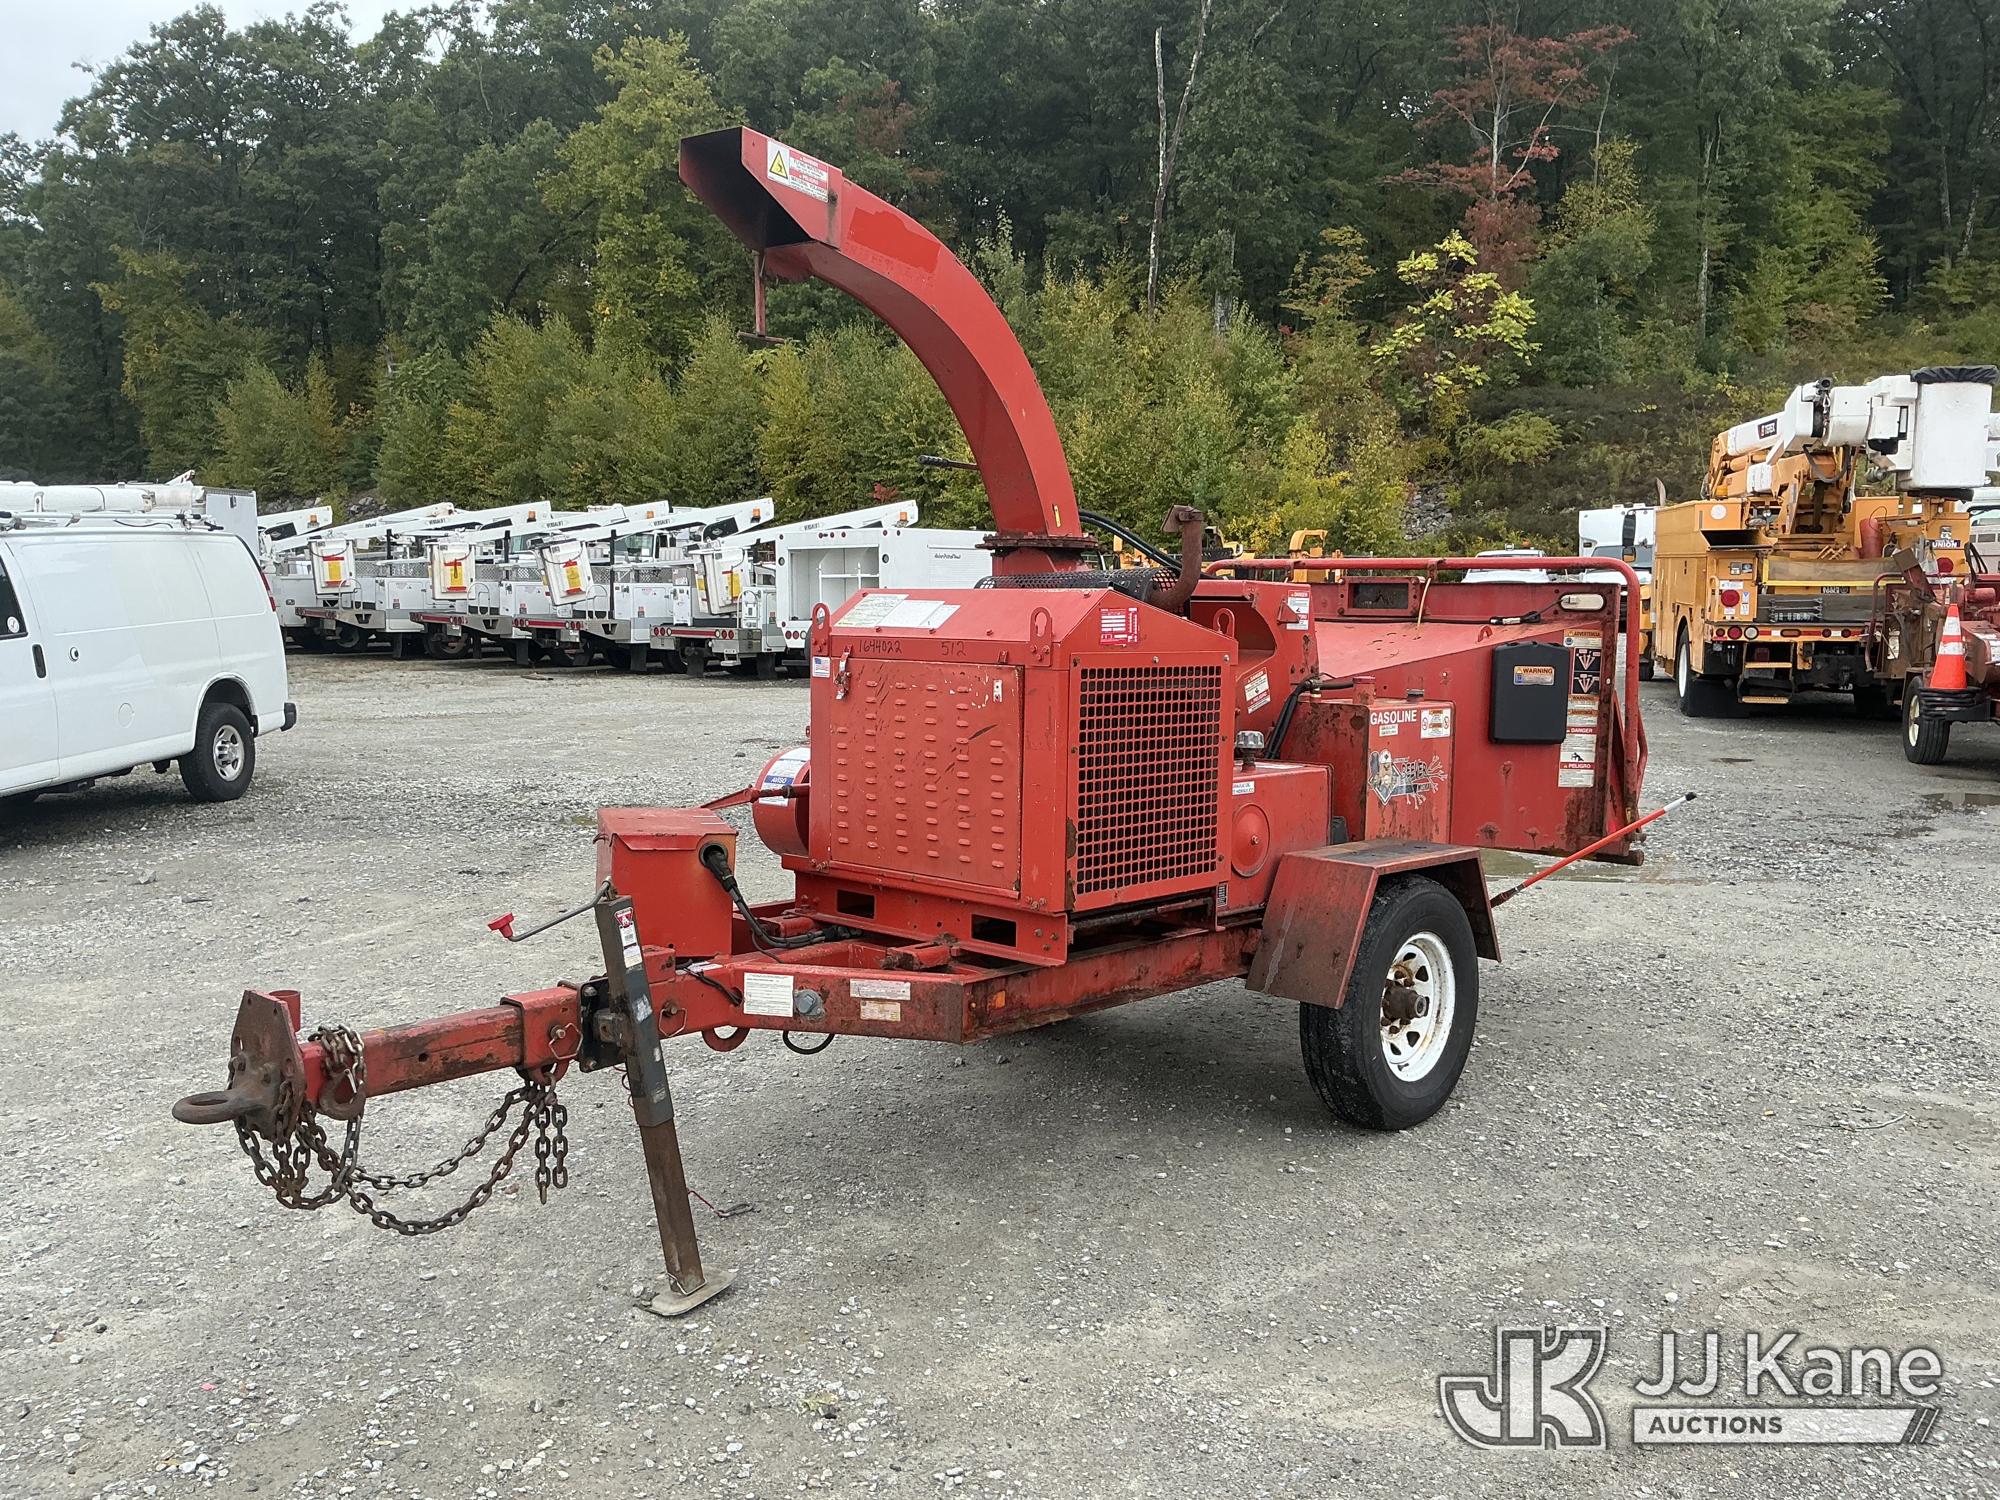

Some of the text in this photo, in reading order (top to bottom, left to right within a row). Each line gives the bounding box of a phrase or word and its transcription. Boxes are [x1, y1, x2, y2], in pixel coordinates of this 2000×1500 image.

[858, 639, 967, 657] 1644022 512
[1522, 667, 1553, 675] WARNING
[1370, 710, 1418, 725] GASOLINE
